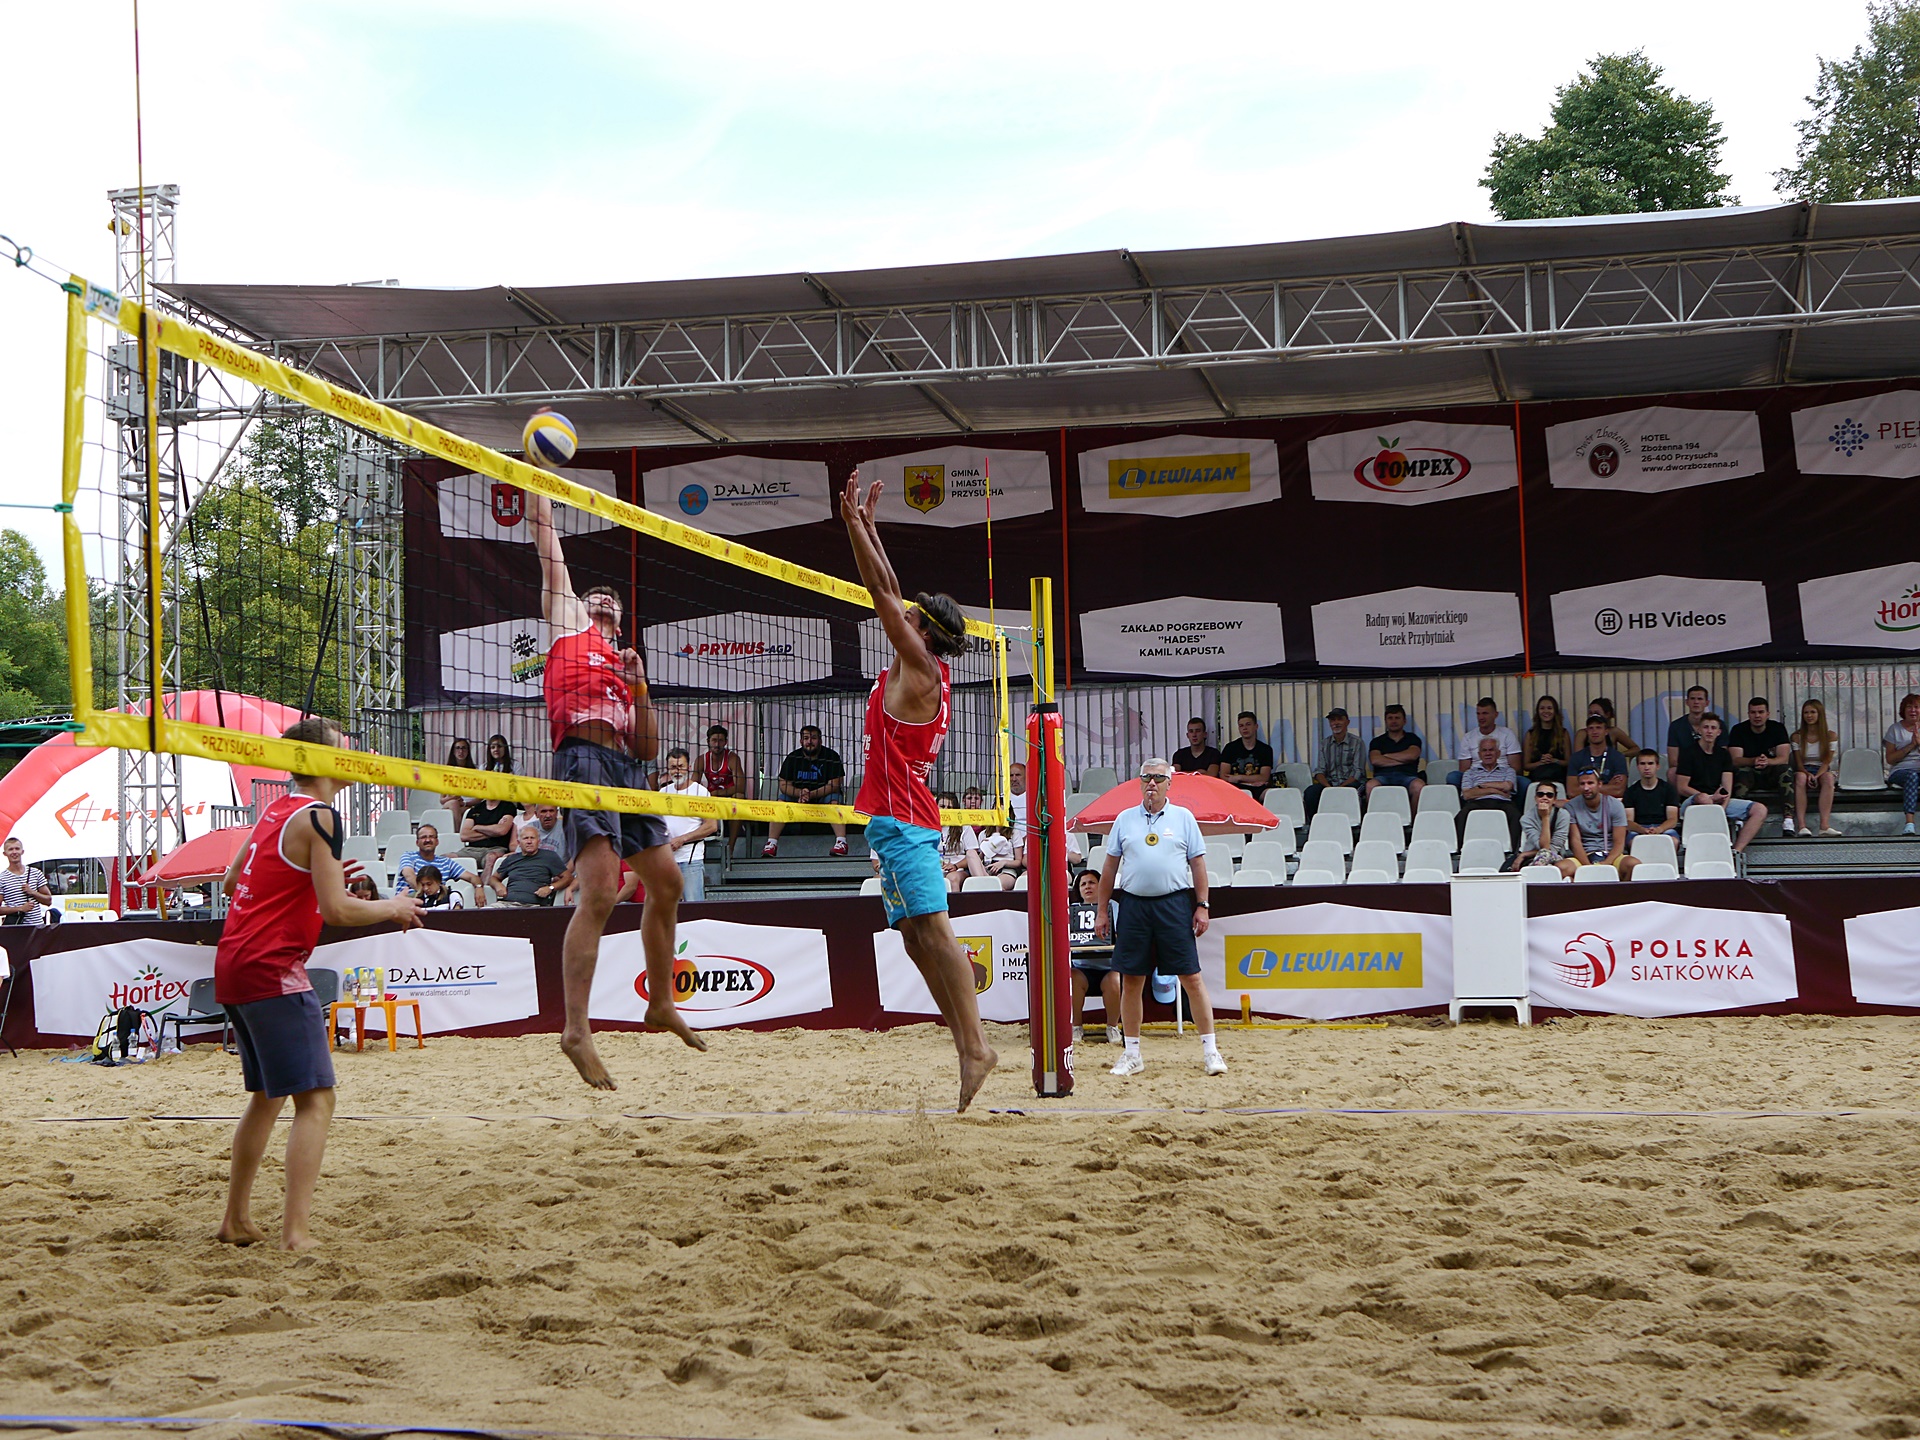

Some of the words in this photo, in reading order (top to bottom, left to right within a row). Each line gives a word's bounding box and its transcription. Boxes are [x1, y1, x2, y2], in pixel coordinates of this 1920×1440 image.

[199, 339, 261, 376] PRZYSUCHA
[330, 392, 382, 425] PRZYSUCHA
[1640, 434, 1671, 442] HOTEL
[1877, 421, 1920, 440] PIE
[438, 436, 482, 466] PRZYSUCHA
[1641, 442, 1683, 453] Zbożenna
[1685, 442, 1700, 450] 194
[1894, 442, 1918, 450] WODA
[1641, 453, 1673, 463] 26-400
[1675, 451, 1719, 462] Przysucha
[1641, 460, 1739, 473] www.dworzbozenna.pl
[951, 469, 980, 478] GMINA
[1149, 467, 1237, 485] LEWIATAN
[1378, 458, 1455, 479] TOMPEX
[531, 473, 571, 498] PRZYSUCHA
[714, 481, 791, 497] DALMET
[956, 479, 989, 488] MIASTO
[1121, 623, 1164, 633] ZAKŁAD
[1166, 621, 1243, 632] POGRZEBOWY
[1365, 614, 1390, 629] Radny
[1391, 612, 1407, 627] woj.
[1408, 610, 1468, 625] Mazowieckiego
[1628, 613, 1658, 629] HB
[1661, 610, 1727, 628] Videos
[1379, 631, 1407, 646] Leszek
[1408, 630, 1455, 646] Przybytniak
[1139, 648, 1173, 657] KAMIL
[1175, 646, 1225, 656] KAPUSTA
[202, 735, 266, 760] PRZYSUCHA
[334, 757, 387, 778] PRZYSUCHA
[443, 773, 488, 791] PRZYSUCHA
[538, 786, 575, 802] PRZYSUCHA
[617, 794, 652, 808] PRZYSUCHA
[243, 843, 257, 875] 2
[1077, 910, 1096, 930] 13
[1630, 939, 1753, 959] POLSKA
[1281, 949, 1404, 973] LEWIATAN
[1631, 960, 1754, 981] SIATKÓWKA
[388, 965, 486, 984] DALMET
[672, 969, 755, 993] OMPEX
[109, 979, 190, 1011] Hortex
[410, 988, 471, 997] www.dalmet.com.pl
